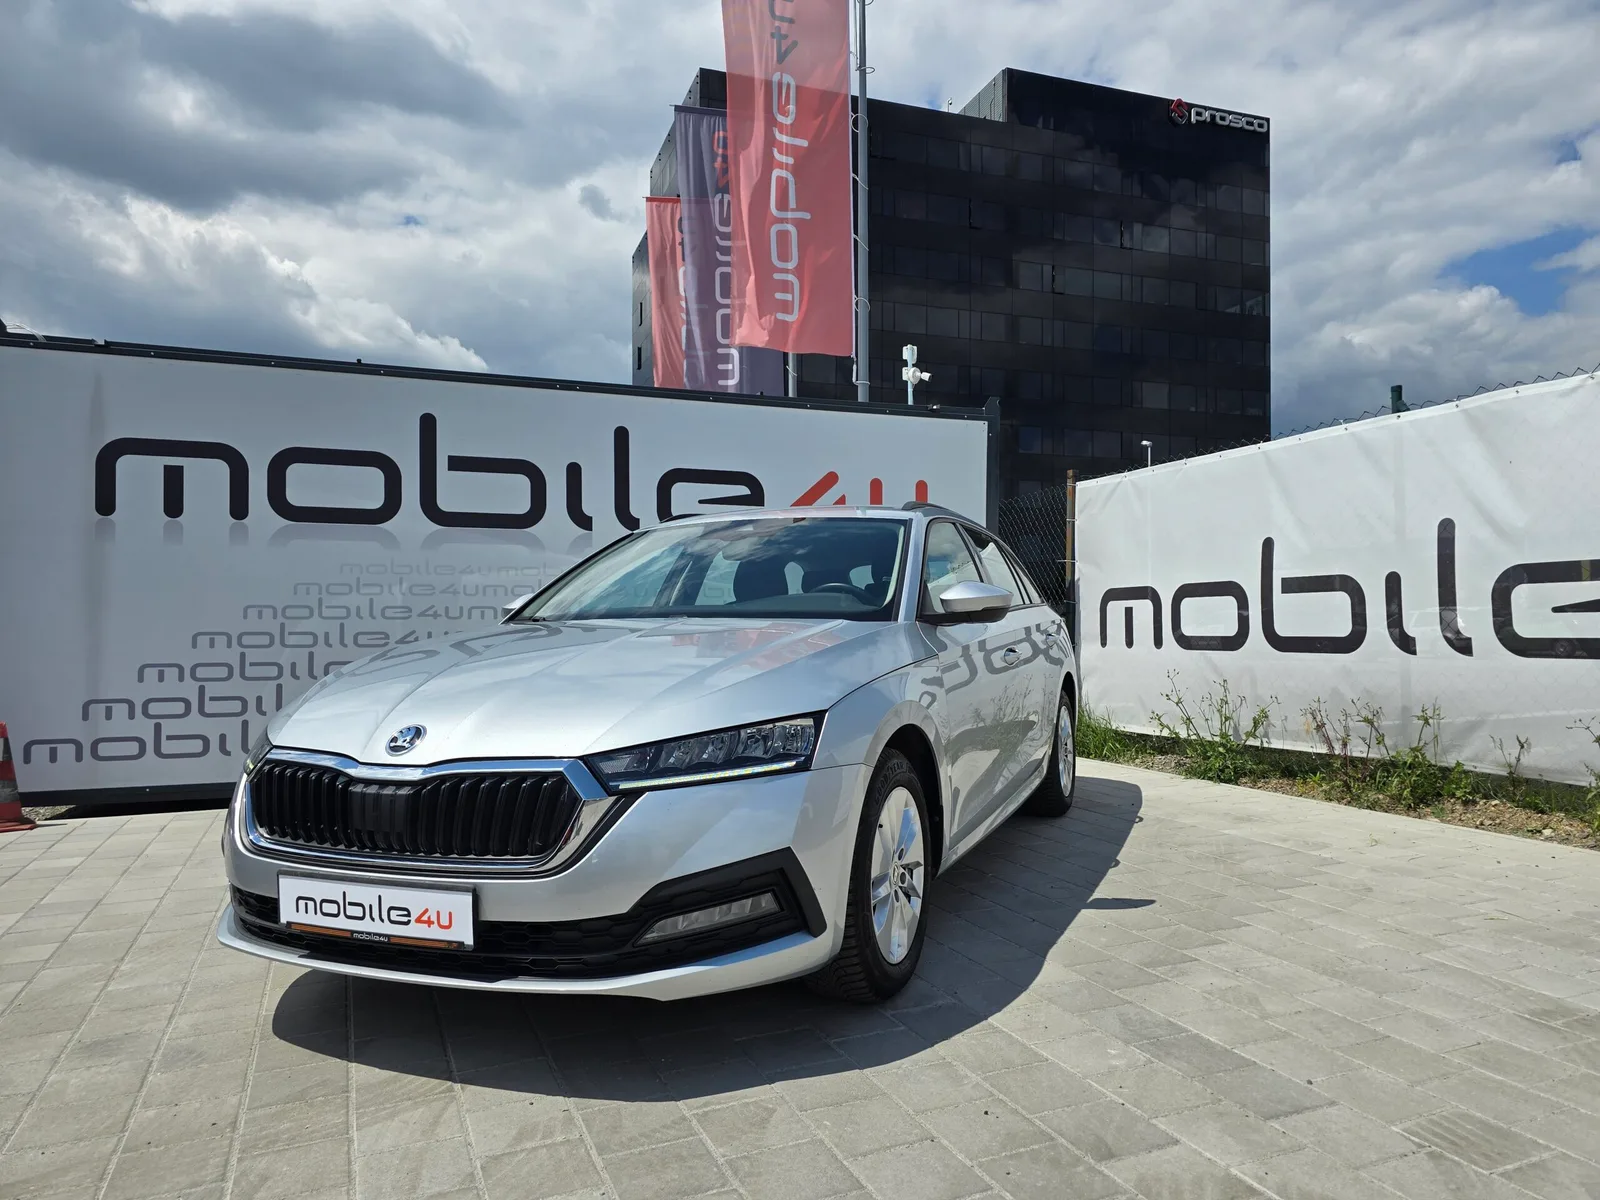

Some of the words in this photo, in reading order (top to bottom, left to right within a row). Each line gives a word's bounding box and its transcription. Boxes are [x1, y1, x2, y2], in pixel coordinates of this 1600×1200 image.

[1191, 107, 1268, 132] prosco
[1100, 518, 1600, 658] mobile
[296, 891, 453, 930] mobile4u
[353, 932, 389, 942] mobile4u
